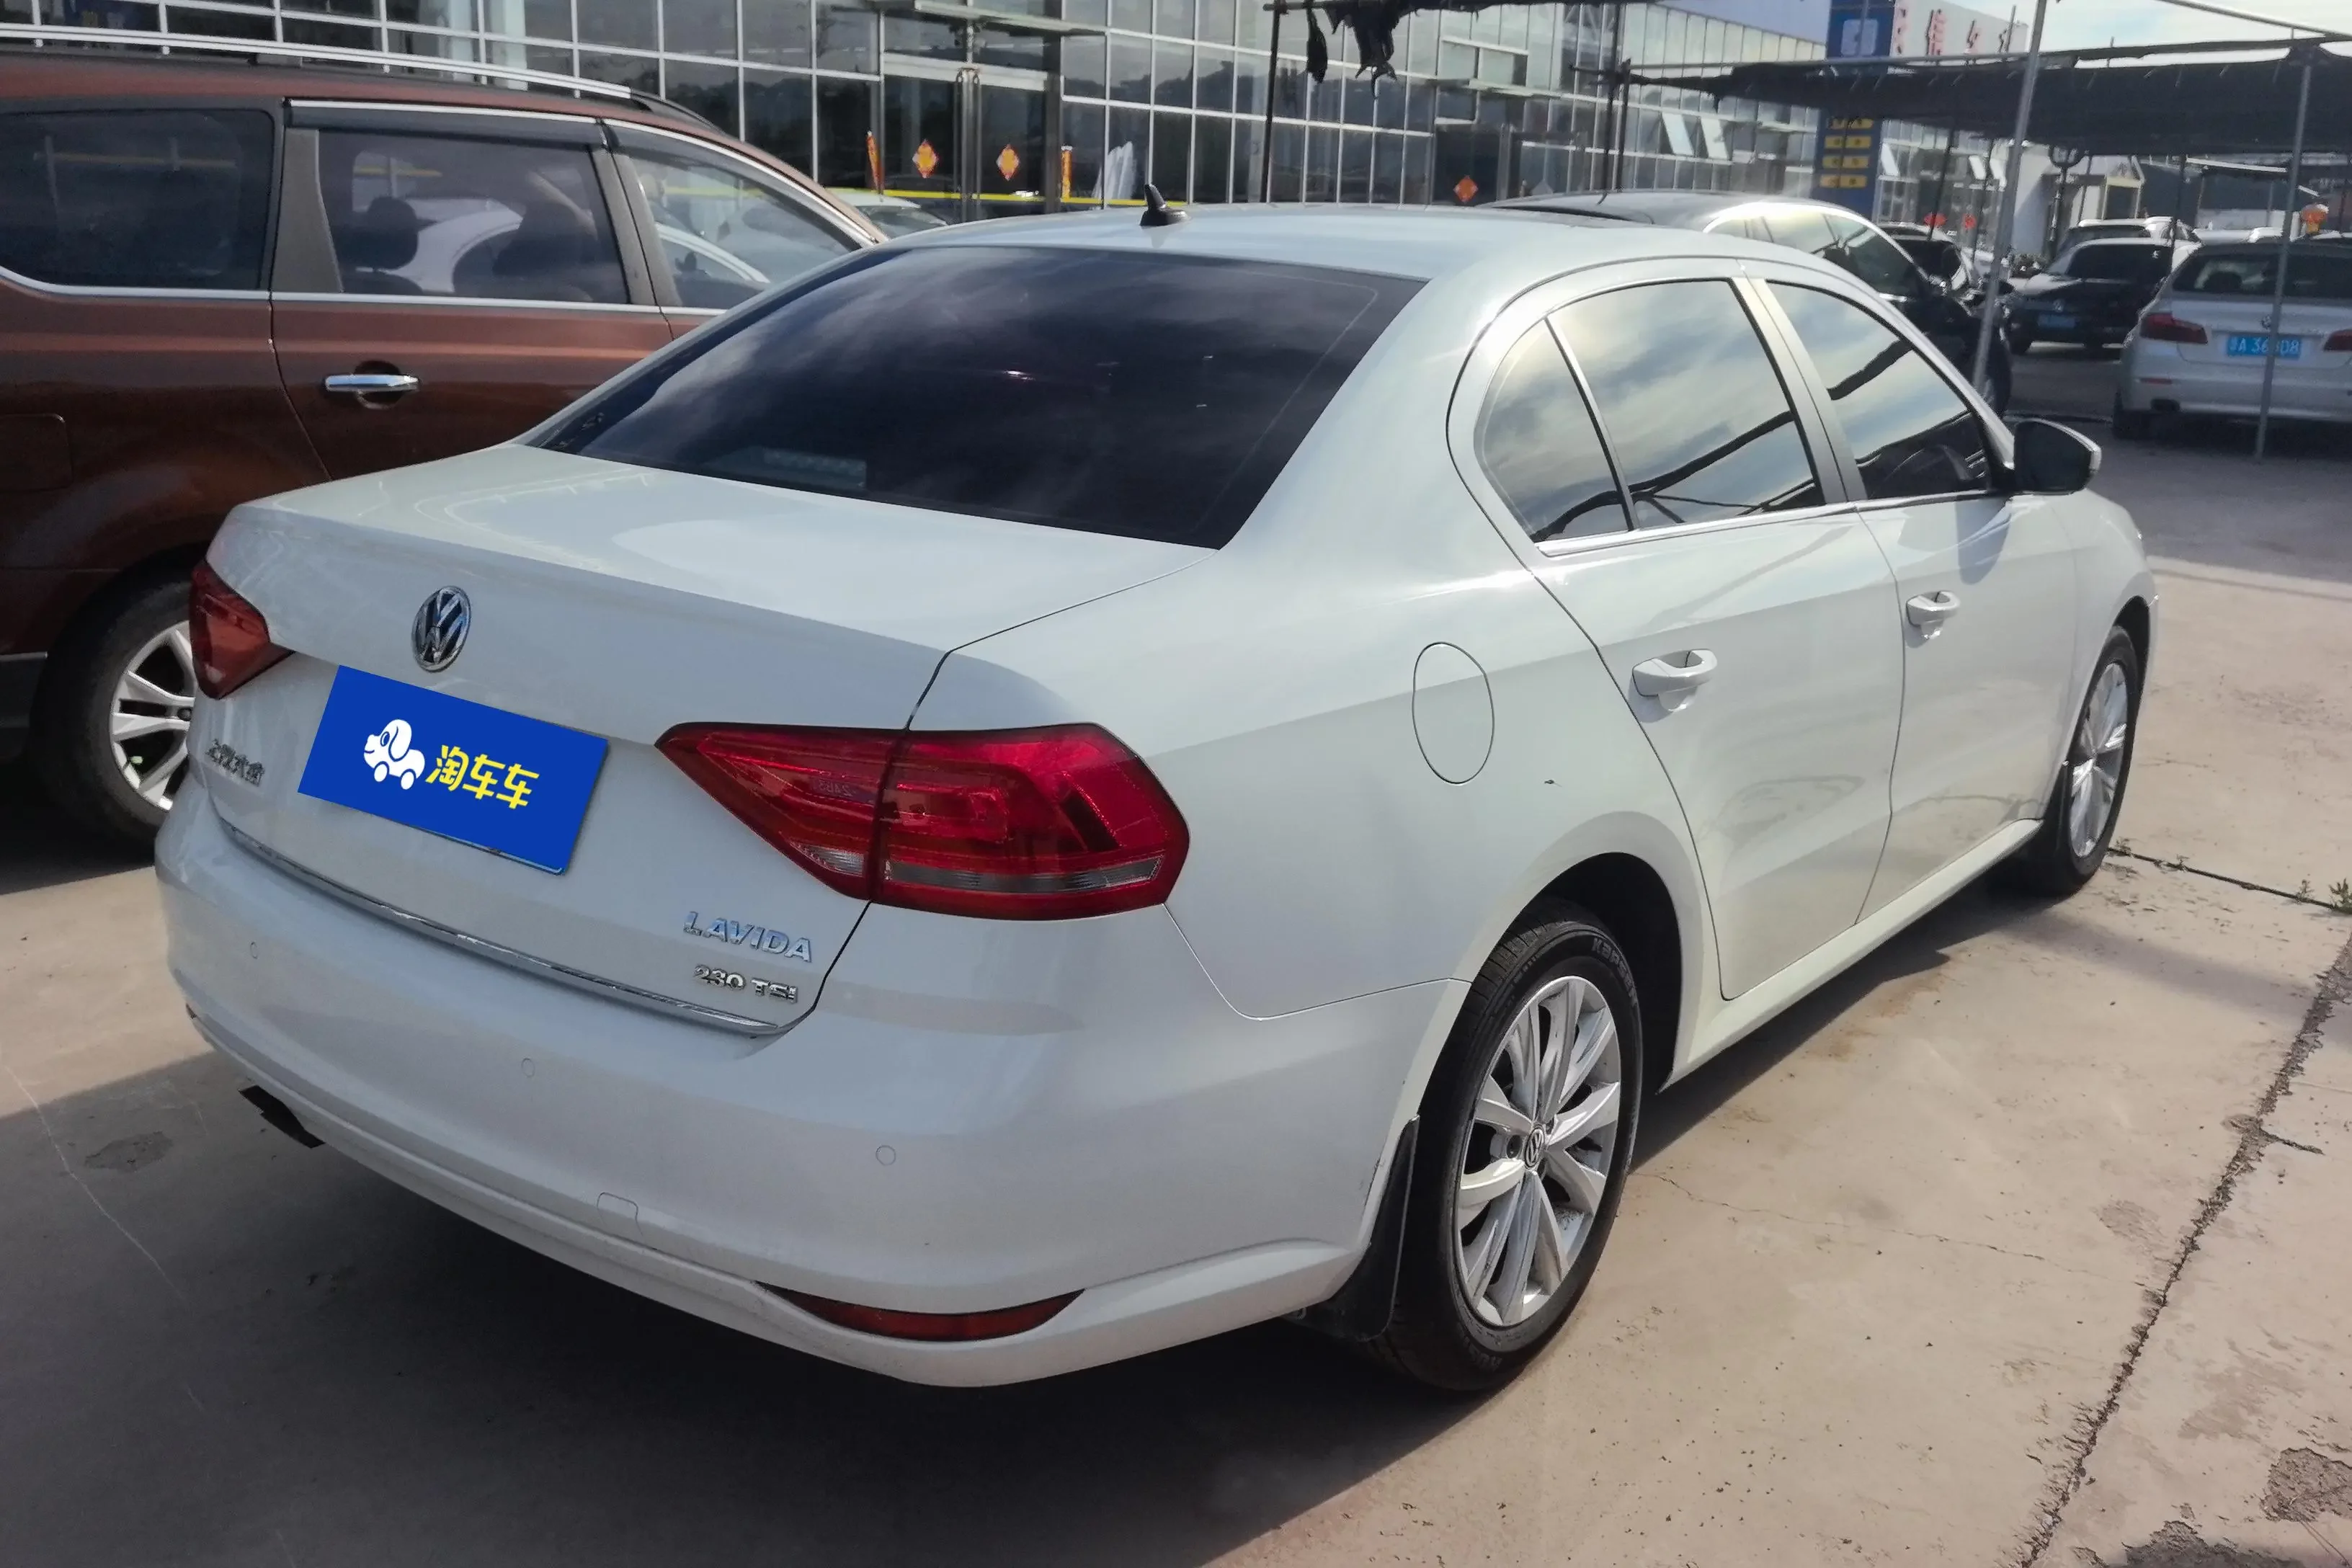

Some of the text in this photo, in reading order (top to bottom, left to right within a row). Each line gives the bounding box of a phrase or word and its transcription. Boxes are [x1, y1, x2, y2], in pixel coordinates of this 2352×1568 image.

[684, 911, 812, 963] LAVIDA
[694, 964, 798, 1004] 230 TSI
